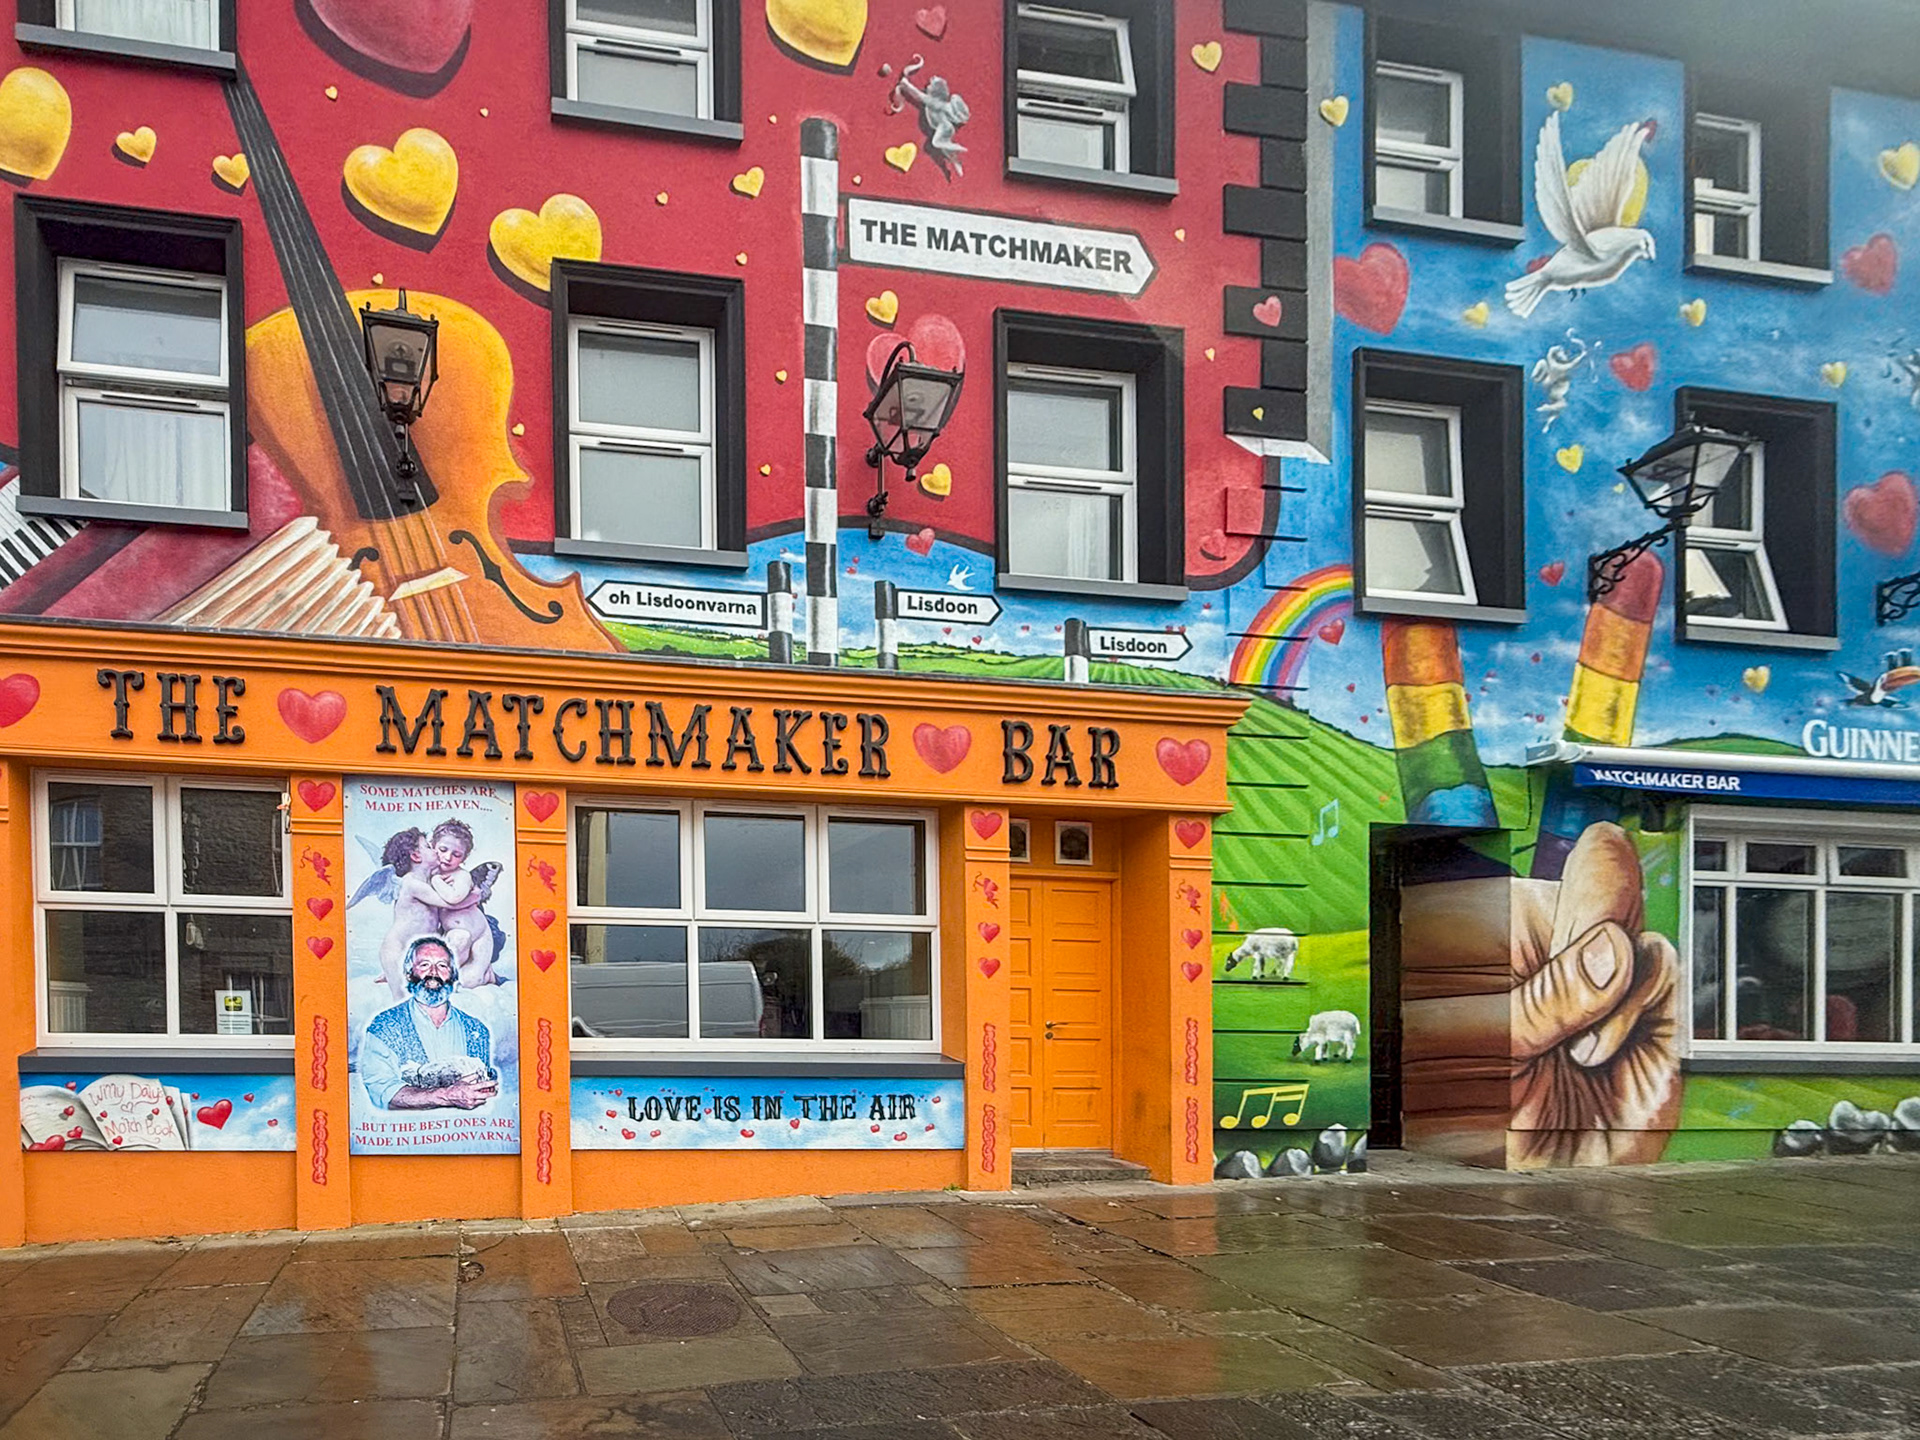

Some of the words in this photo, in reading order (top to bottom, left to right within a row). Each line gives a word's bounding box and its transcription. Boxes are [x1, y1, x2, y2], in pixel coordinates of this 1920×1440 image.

[859, 218, 918, 248] THE
[926, 226, 1134, 275] MATCHMAKER
[608, 590, 631, 606] oh
[635, 591, 758, 617] Lisdoonvarna
[906, 595, 979, 616] Lisdoon
[1099, 636, 1168, 655] Lisdoon
[97, 668, 247, 745] THE
[375, 684, 892, 779] MATCHMAKER
[1000, 719, 1122, 790] BAR
[360, 784, 399, 797] SOME
[402, 785, 467, 798] MATCHES
[470, 786, 497, 797] ARE
[1706, 775, 1741, 791] BAR
[365, 800, 405, 812] MADE
[408, 801, 422, 812] IN
[626, 1096, 701, 1122] LOVE
[712, 1096, 741, 1122] IS
[751, 1095, 783, 1121] IN
[793, 1094, 857, 1121] THE
[868, 1094, 917, 1121] AIR
[390, 1122, 416, 1132] THE
[420, 1119, 450, 1131] BEST
[453, 1117, 487, 1128] ONES
[490, 1117, 515, 1128] ARE
[355, 1135, 393, 1146] MADE
[397, 1134, 409, 1146] IN
